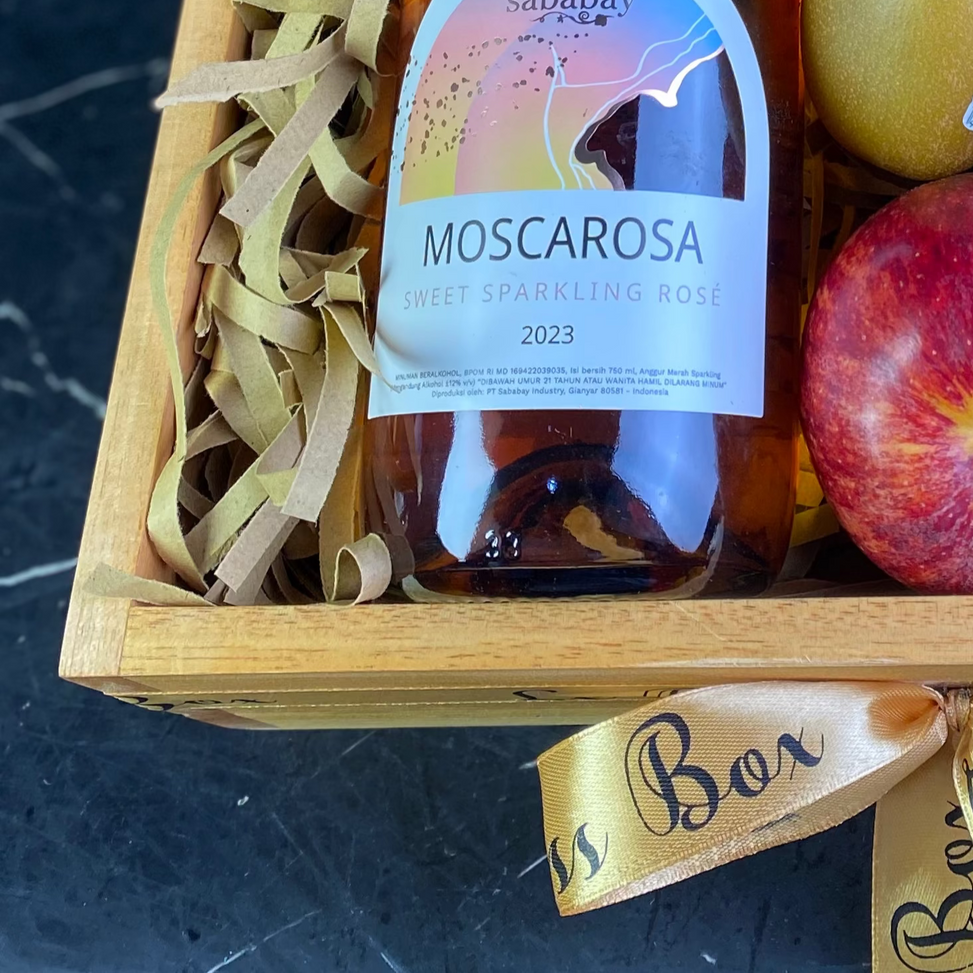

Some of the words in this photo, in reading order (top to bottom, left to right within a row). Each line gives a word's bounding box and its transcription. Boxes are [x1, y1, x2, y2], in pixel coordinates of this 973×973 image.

[423, 216, 703, 267] MOSCAROSA
[403, 285, 470, 310] SWEET
[482, 281, 643, 303] SPARKLING
[658, 283, 721, 307] ROSÉ
[520, 325, 574, 345] 2023
[419, 369, 462, 379] BERALKOHOL,
[464, 368, 484, 377] BPOM
[486, 368, 494, 376] RI
[496, 368, 508, 376] MD
[510, 367, 567, 376] 169422039035,
[581, 367, 606, 375] bersih
[608, 367, 622, 375] 750
[639, 368, 665, 377] Anggur
[667, 368, 689, 377] Merah
[691, 370, 721, 380] Sparkling
[422, 380, 443, 389] Alkohol
[518, 377, 541, 385] UMUR
[543, 377, 552, 385] 21
[554, 377, 581, 385] TAHUN
[583, 377, 603, 385] ATAU
[605, 377, 635, 385] WANITA
[638, 377, 662, 386] HAMIL
[664, 378, 700, 388] DILARANG
[431, 389, 465, 398] Diproduksi
[467, 388, 484, 396] oleh:
[486, 388, 496, 396] PT
[498, 387, 530, 397] Sababay
[532, 387, 566, 397] Industry,
[568, 387, 598, 396] Gianyar
[600, 387, 623, 395] 80581
[632, 387, 669, 396] Indonesia
[624, 712, 824, 837] Box
